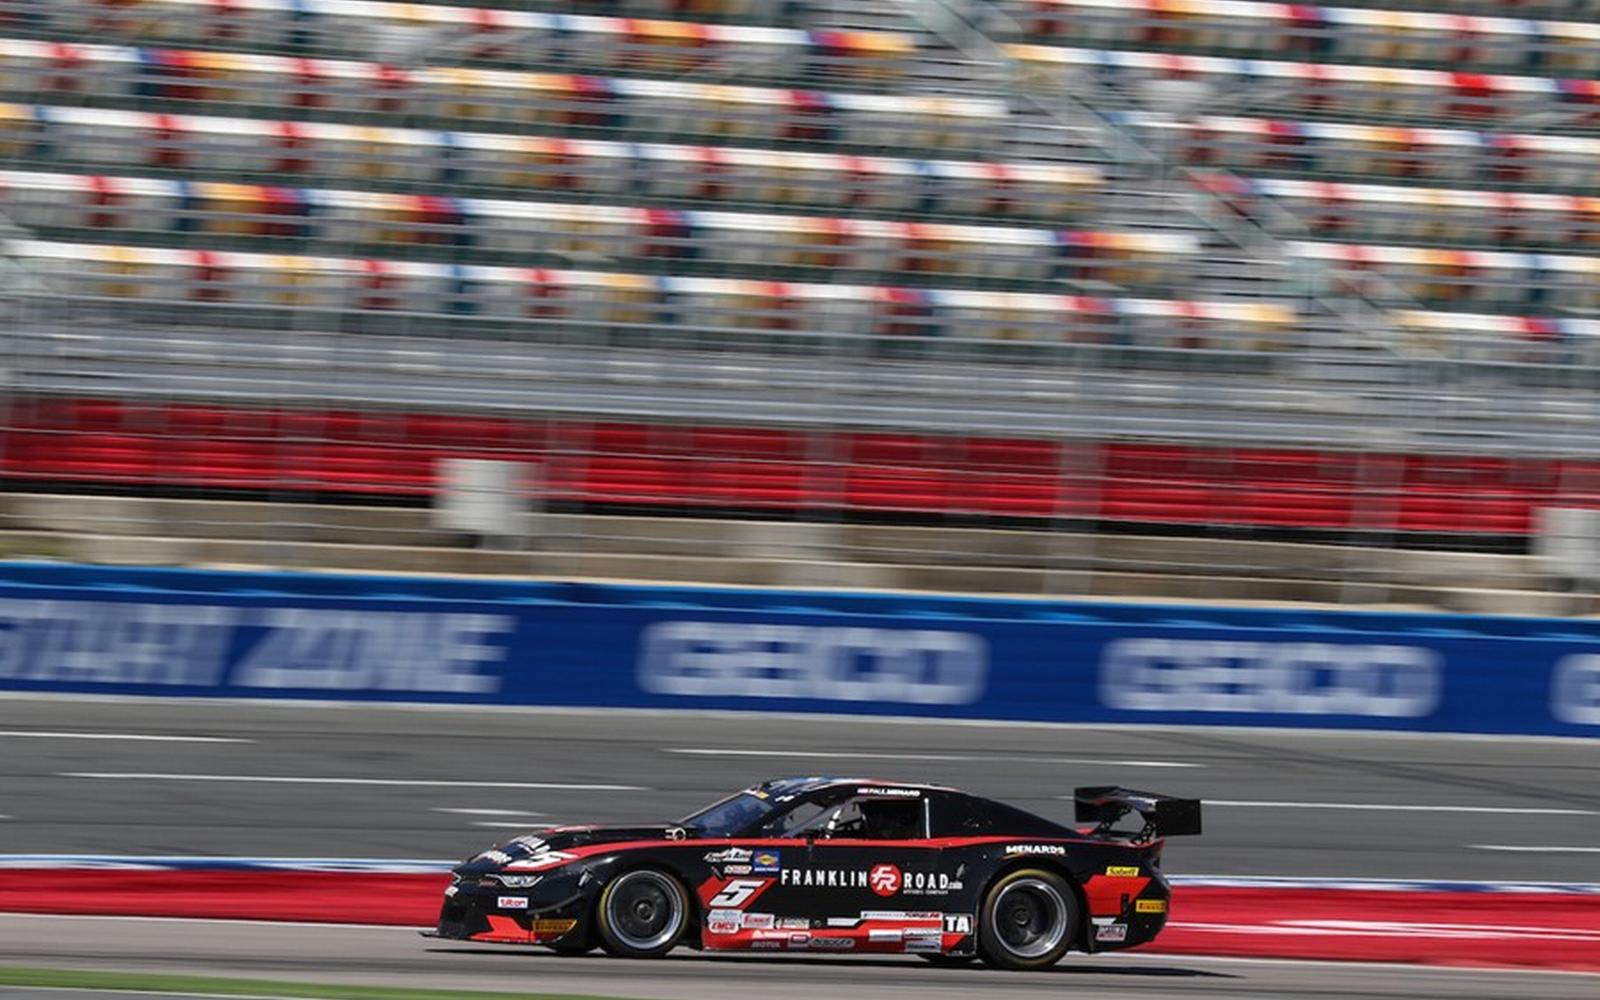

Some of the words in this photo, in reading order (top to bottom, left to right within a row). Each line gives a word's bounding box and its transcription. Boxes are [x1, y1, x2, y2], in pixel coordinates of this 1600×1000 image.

[637, 620, 988, 706] GEICO
[1100, 636, 1443, 718] GEICO
[1005, 844, 1066, 855] MENARDS
[780, 869, 868, 887] FRANKLIN
[709, 879, 766, 907] 5
[500, 898, 526, 908] tilton
[945, 916, 970, 932] TA
